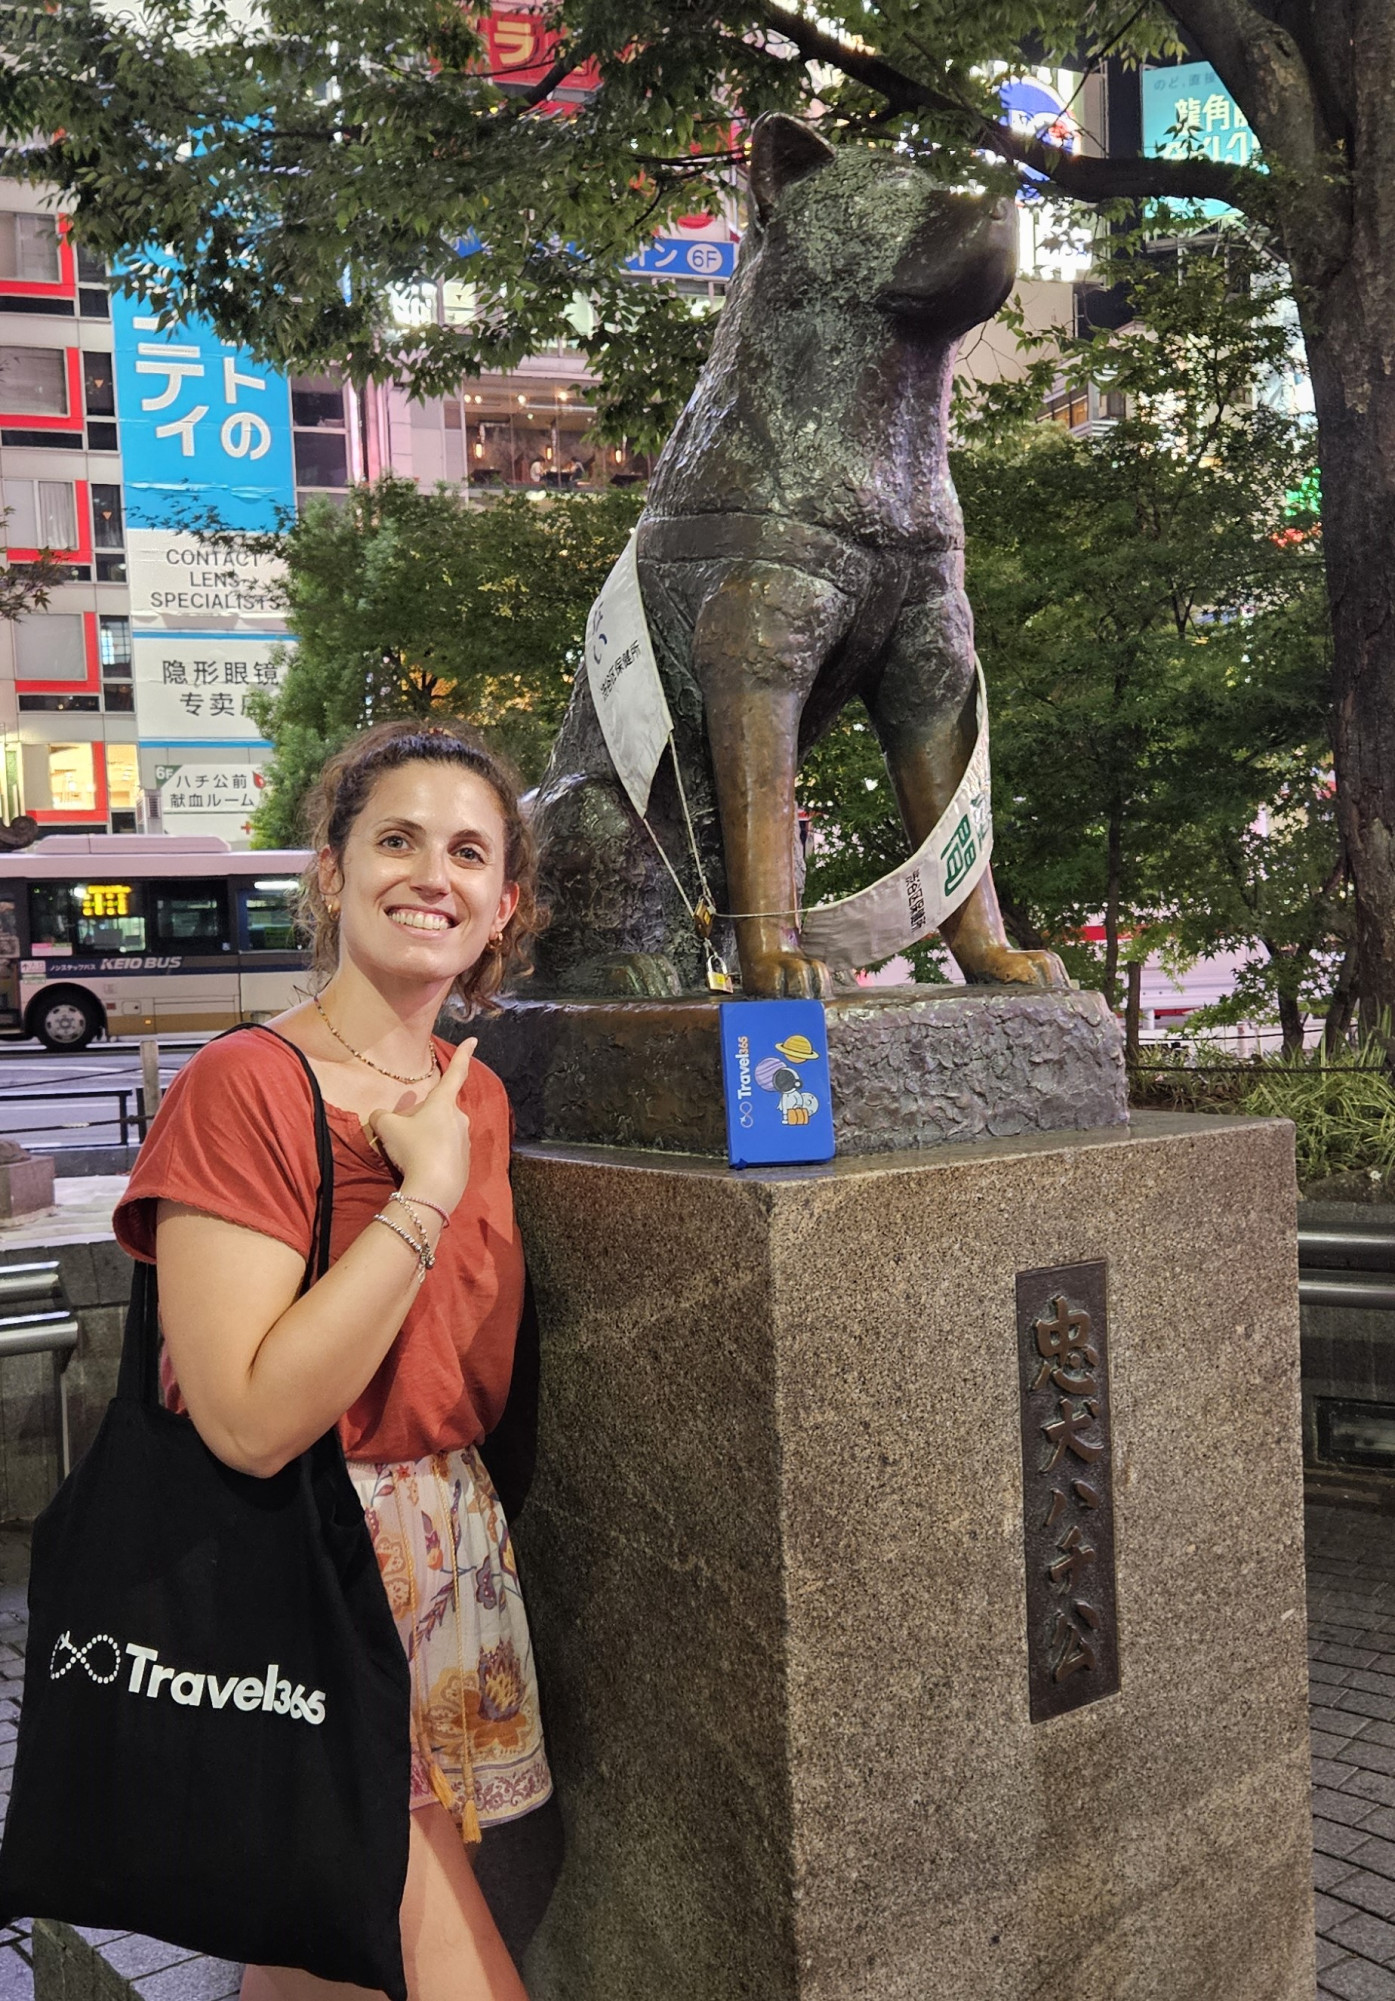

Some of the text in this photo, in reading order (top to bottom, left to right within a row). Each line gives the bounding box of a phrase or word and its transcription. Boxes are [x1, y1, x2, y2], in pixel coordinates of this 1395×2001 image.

[494, 21, 534, 64] ラ
[692, 249, 717, 268] 6F
[133, 316, 210, 457] ティ
[166, 549, 260, 567] CONTACT
[162, 660, 280, 686] 隐形眼镜
[156, 766, 174, 780] 6F
[176, 774, 247, 789] ハチ公前
[170, 793, 255, 808] 献血ルーム
[905, 867, 926, 933] 渋谷区保健所
[101, 956, 182, 970] KEIO BUS
[735, 1036, 752, 1100] Travel365
[1030, 1295, 1103, 1684] 忠犬ハチ公
[125, 1642, 326, 1725] Travel365
